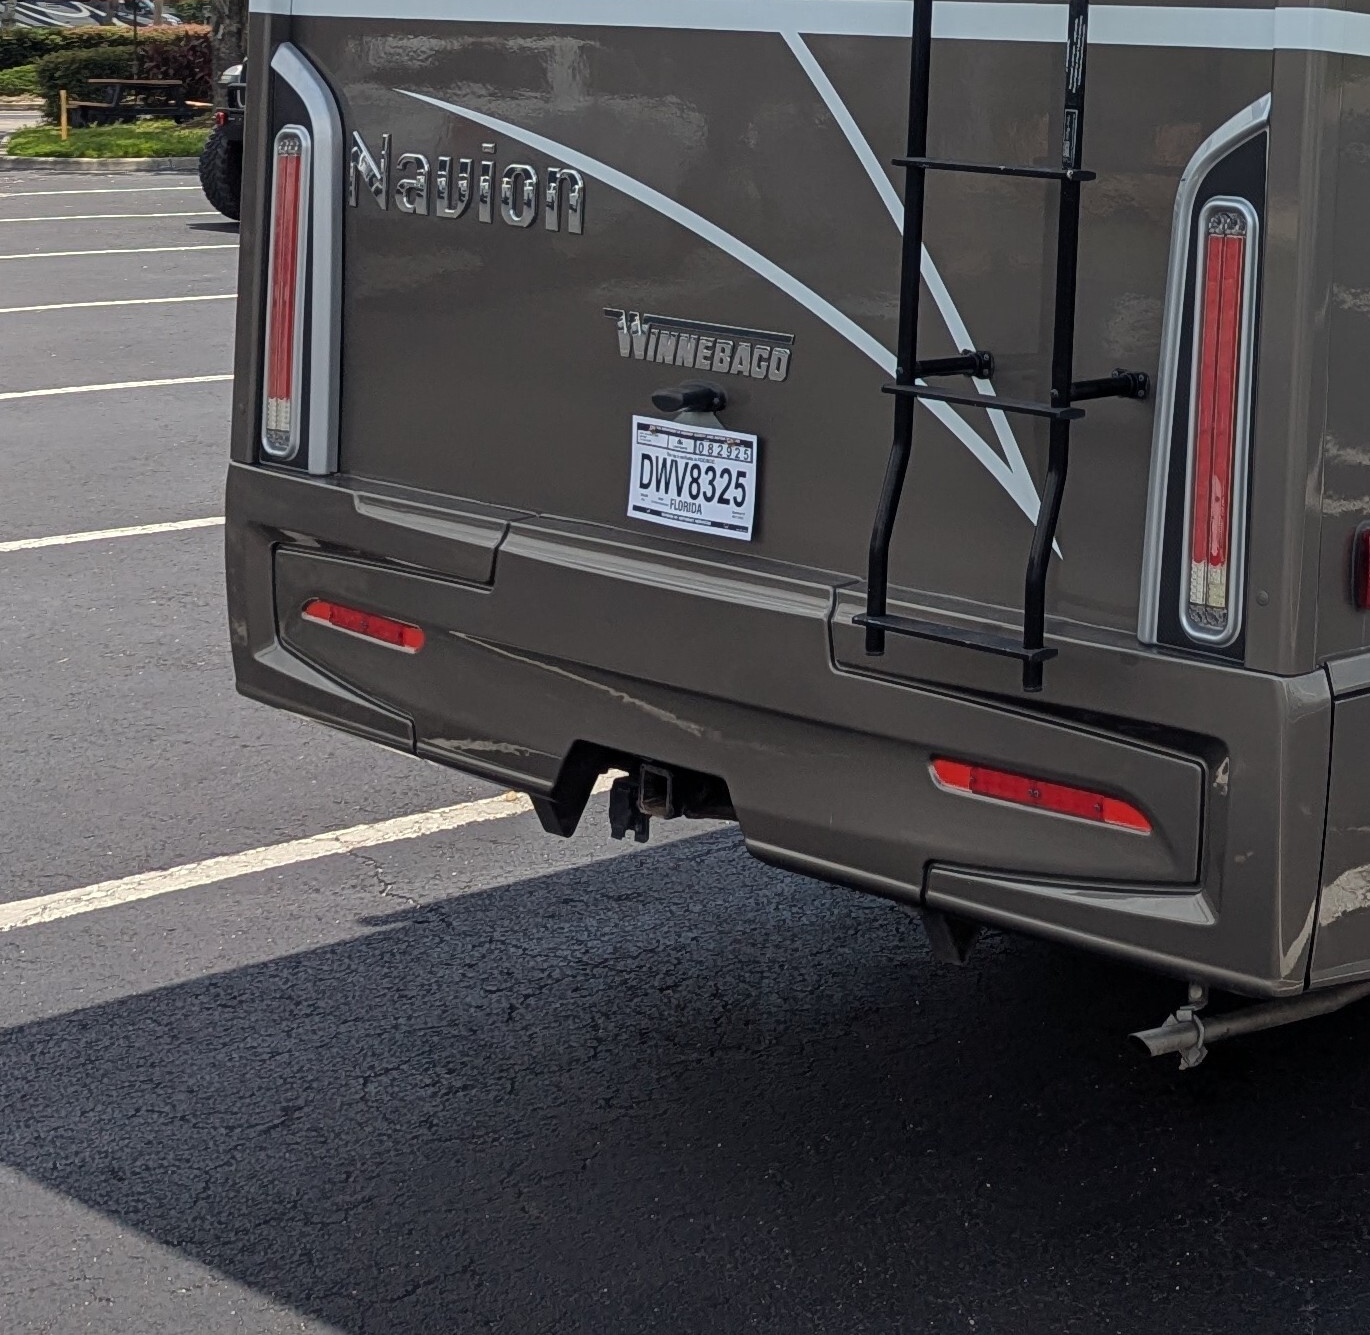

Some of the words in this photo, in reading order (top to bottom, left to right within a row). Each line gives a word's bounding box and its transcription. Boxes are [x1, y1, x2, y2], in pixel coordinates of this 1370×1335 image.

[350, 130, 586, 235] Navion
[612, 310, 793, 382] WINNEBAGO
[639, 452, 748, 508] DWV8325
[669, 498, 703, 516] FLORIDA
